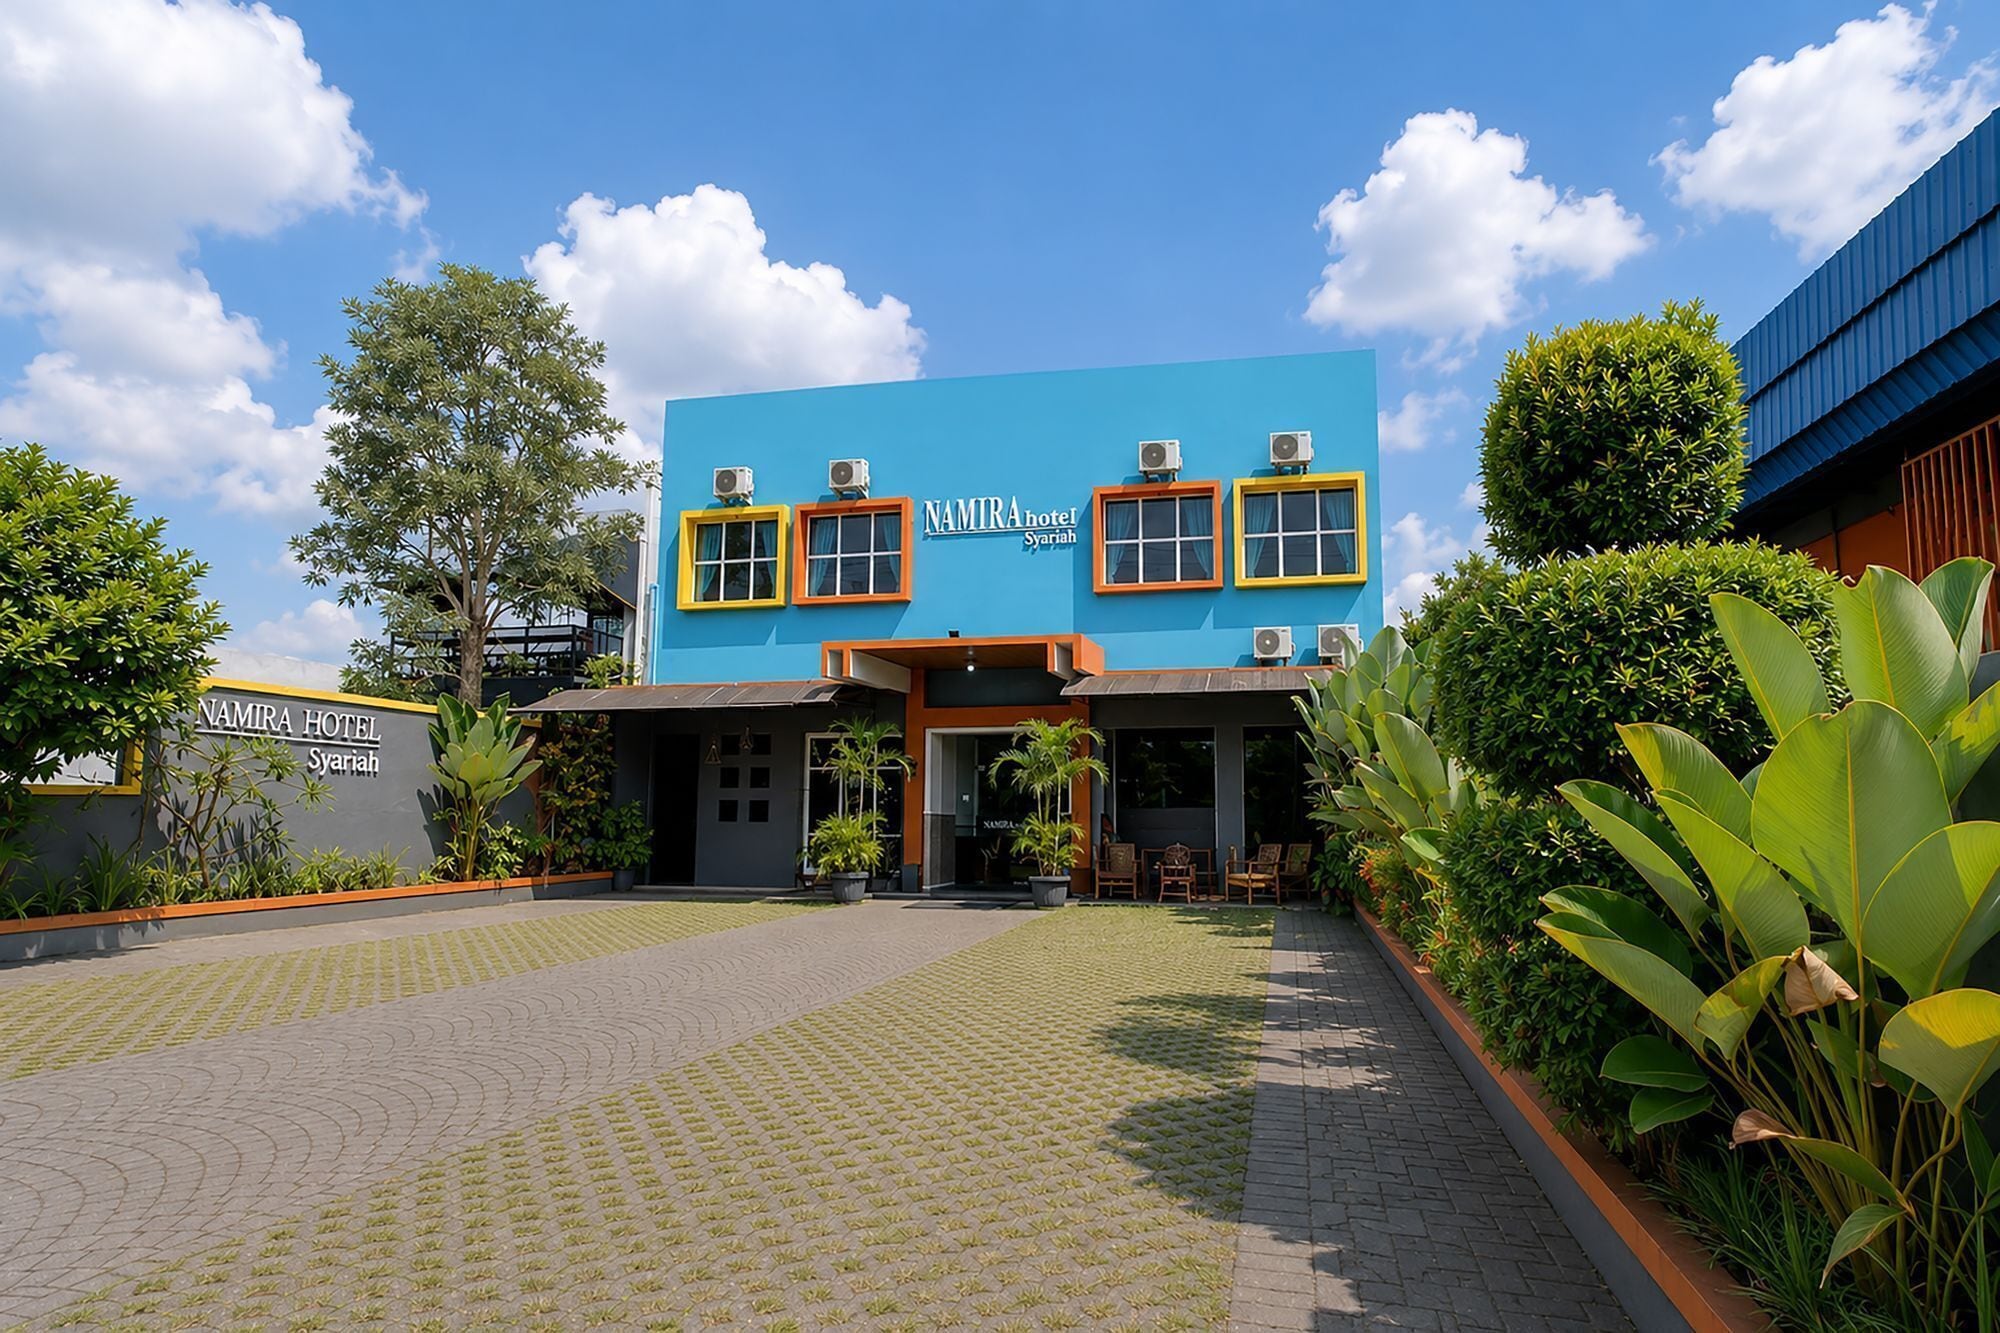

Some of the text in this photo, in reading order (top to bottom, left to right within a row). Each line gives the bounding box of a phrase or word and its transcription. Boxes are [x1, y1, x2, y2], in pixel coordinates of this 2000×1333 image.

[924, 495, 1077, 533] NAMIRA hotel
[1024, 529, 1077, 548] Syariah
[196, 697, 382, 741] NAMIRA HOTEL
[308, 747, 379, 776] Syariah
